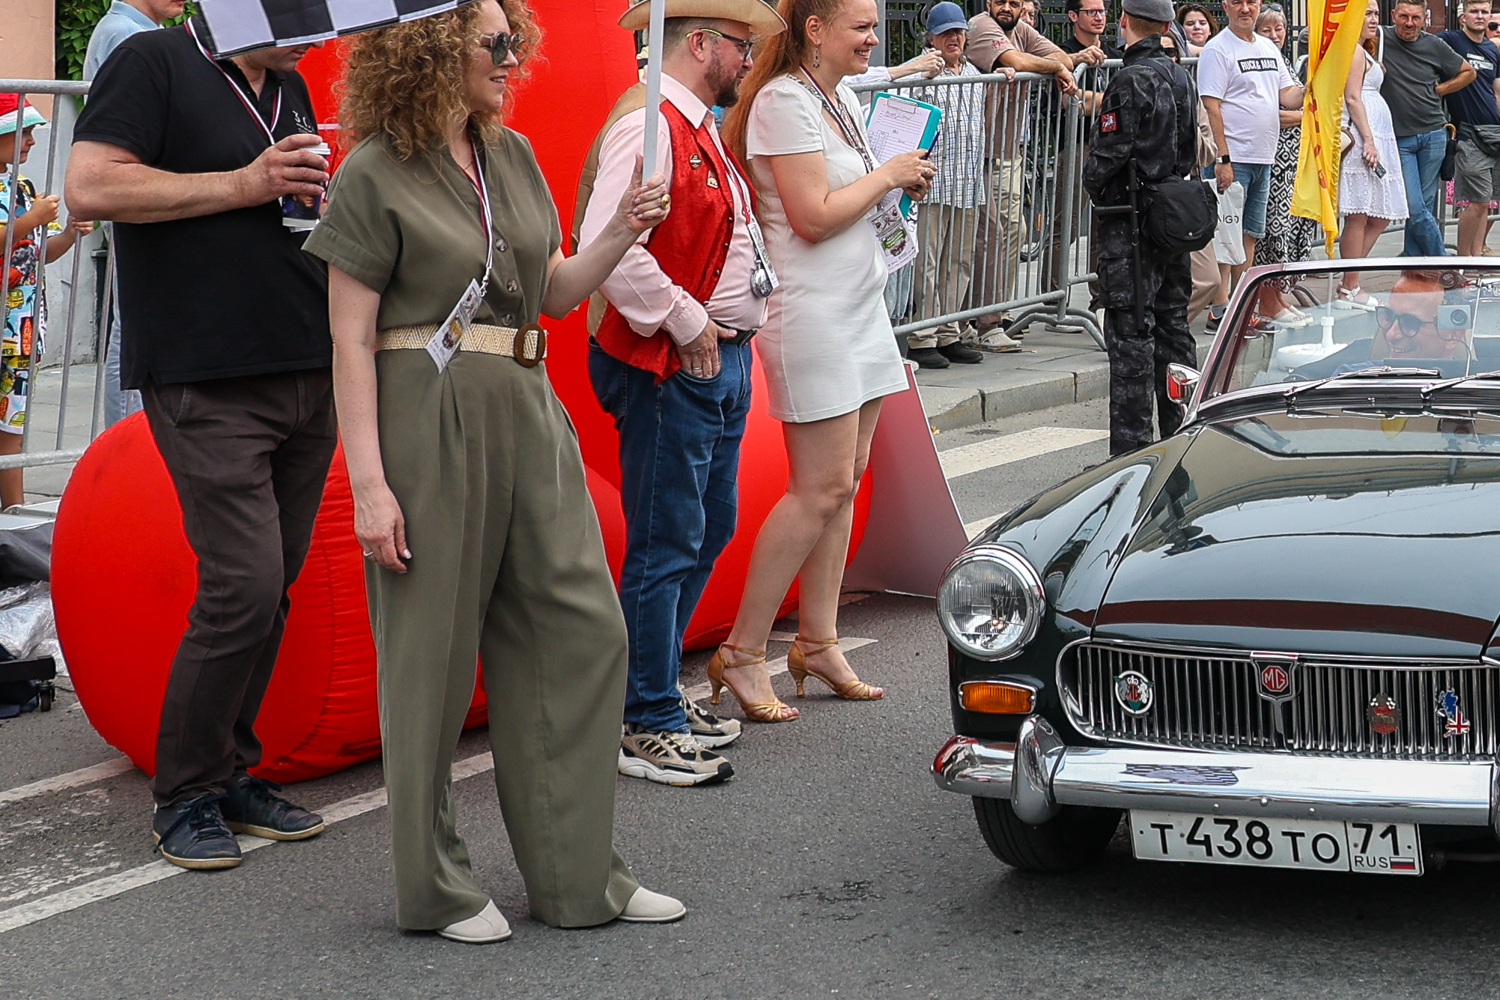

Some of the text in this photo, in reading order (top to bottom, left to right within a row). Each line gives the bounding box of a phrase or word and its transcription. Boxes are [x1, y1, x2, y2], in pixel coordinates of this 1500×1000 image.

[1217, 214, 1239, 224] NGO
[1264, 667, 1287, 690] MG
[1352, 823, 1400, 856] 71
[1354, 855, 1388, 868] RUS
